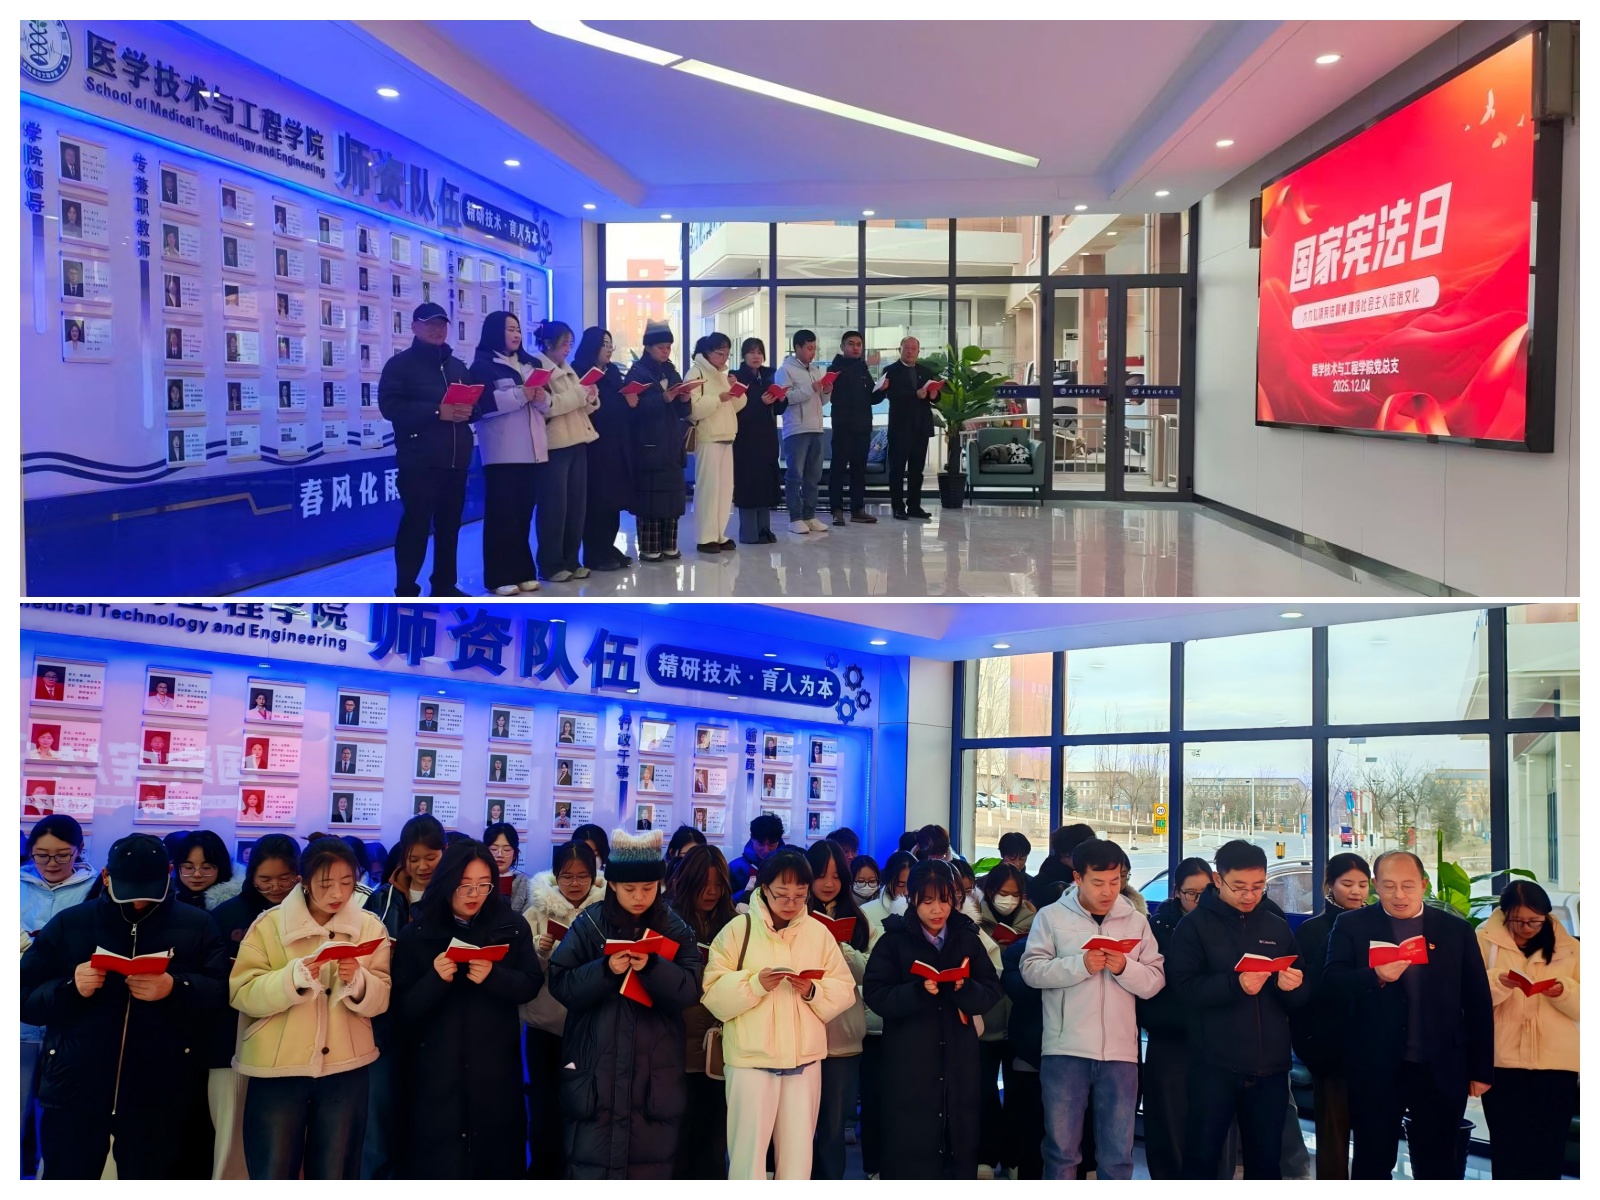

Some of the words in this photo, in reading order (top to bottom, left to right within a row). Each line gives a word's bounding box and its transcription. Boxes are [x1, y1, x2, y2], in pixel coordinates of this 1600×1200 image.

[86, 30, 325, 161] 医学技术与工程学院
[86, 76, 132, 105] School
[135, 98, 147, 113] of
[150, 101, 195, 129] Medical
[198, 118, 256, 153] Technology
[256, 143, 275, 158] and
[276, 148, 326, 180] Engineering
[23, 121, 45, 213] 学院领导
[133, 152, 150, 258] 专兼职教师
[332, 131, 462, 229] 师资队伍
[1290, 181, 1452, 293] 国家宪法日
[1311, 358, 1399, 377] 医学技术与工程学院党总支
[1333, 379, 1371, 393] 2025.12.04
[300, 468, 401, 519] 春风化雨
[99, 604, 209, 634] Technology
[213, 621, 246, 637] and
[249, 624, 347, 652] Engineering
[368, 603, 640, 694] 师资队伍
[616, 714, 632, 780] 行政干事
[745, 727, 758, 772] 辅导员
